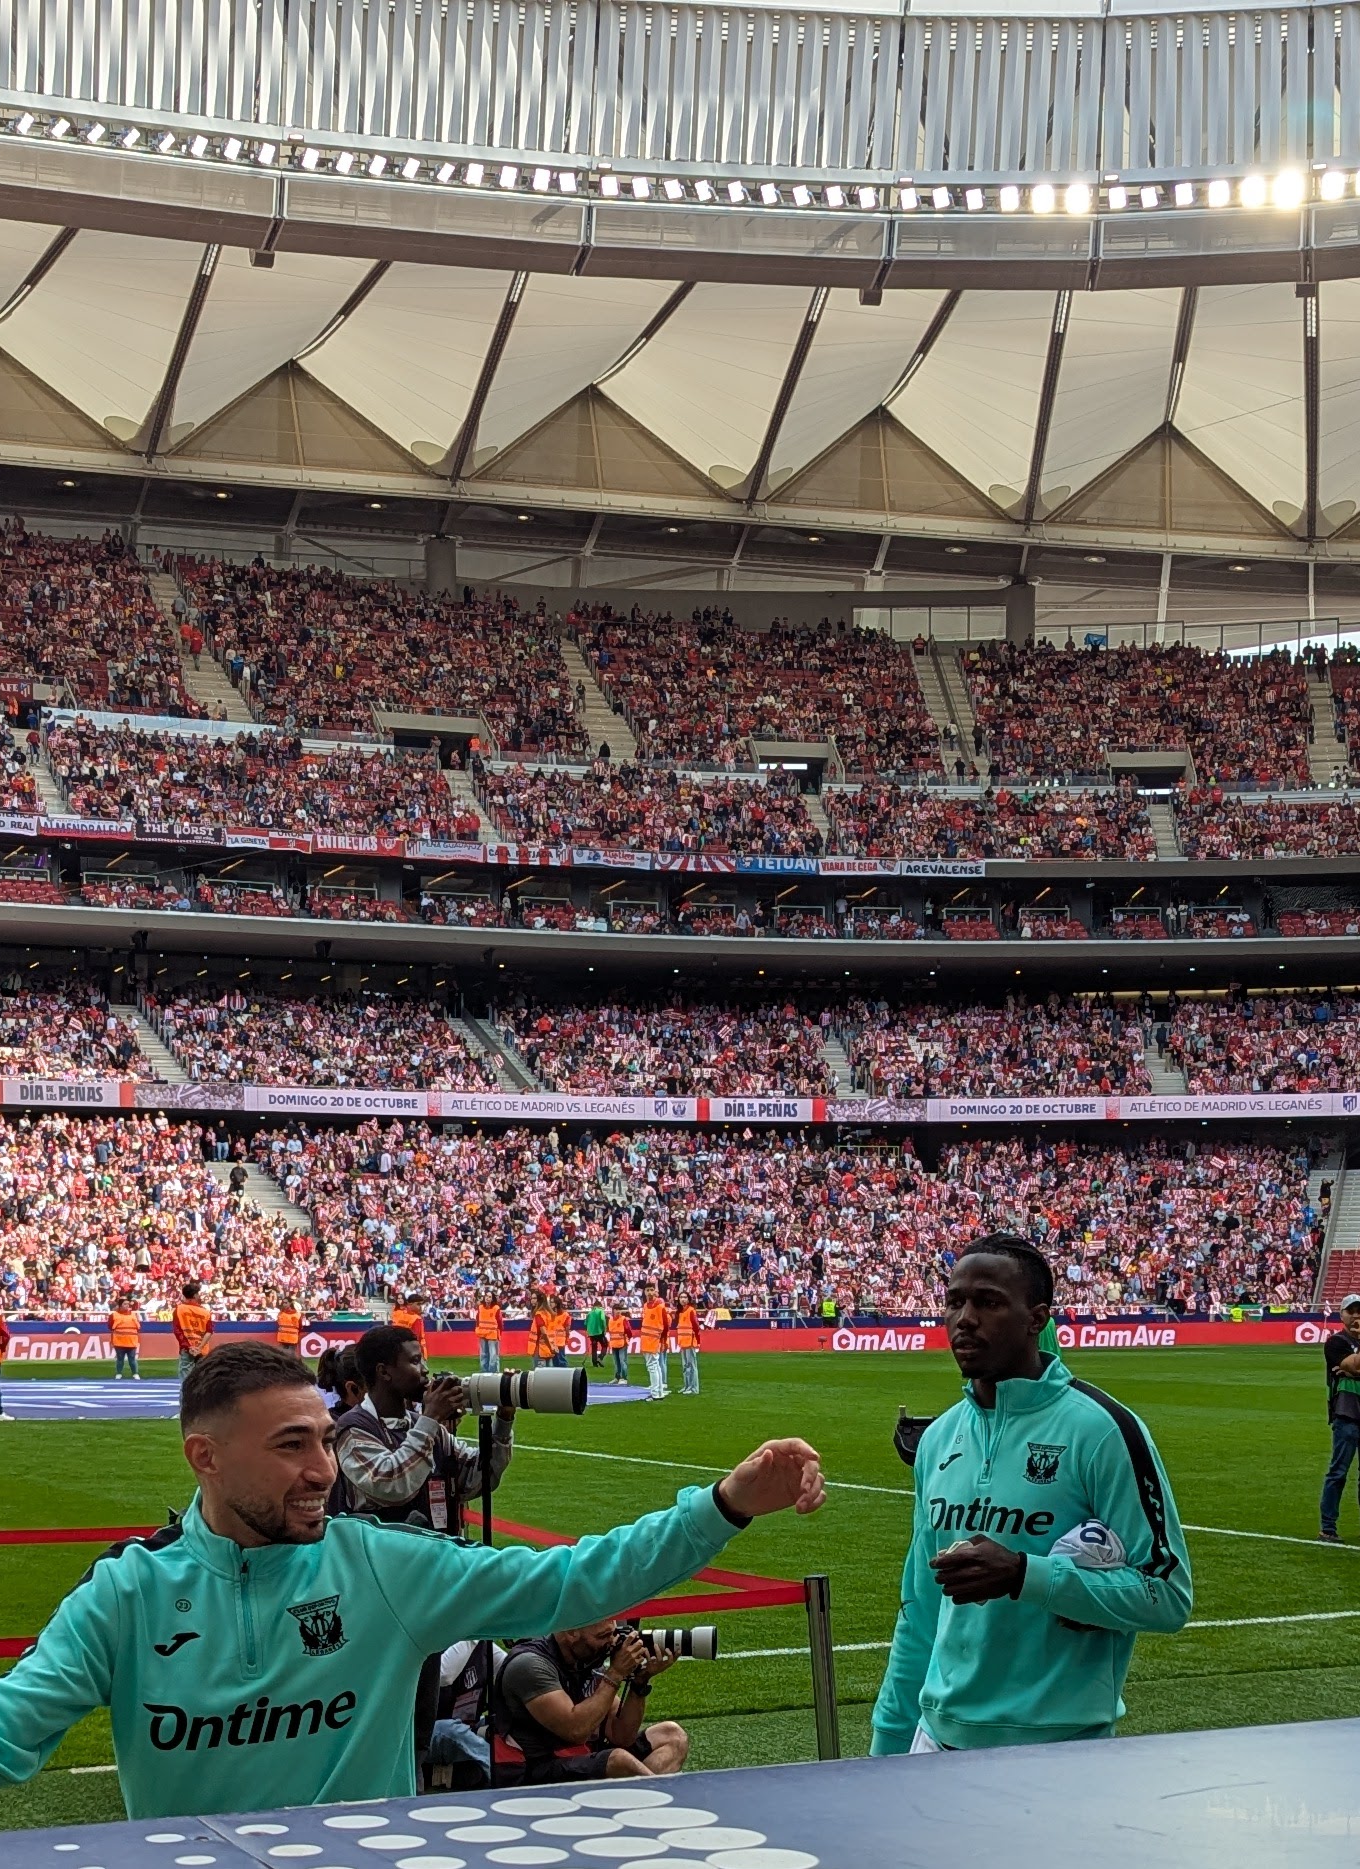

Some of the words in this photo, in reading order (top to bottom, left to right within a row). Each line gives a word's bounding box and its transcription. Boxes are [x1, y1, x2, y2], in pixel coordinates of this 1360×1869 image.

[10, 819, 34, 832] REAL
[143, 823, 168, 834] THE
[905, 862, 983, 875] AREVALENSE
[20, 1081, 44, 1101] DÍA
[59, 1082, 104, 1102] PEÑAS
[268, 1094, 327, 1106] DOMINGO
[330, 1096, 344, 1107] 20
[346, 1097, 362, 1108] DE
[364, 1098, 419, 1109] OCTUBRE
[451, 1098, 502, 1111] ATLÉTICO
[504, 1100, 518, 1112] DE
[521, 1101, 564, 1113] MADRID
[566, 1102, 582, 1113] VS.
[584, 1101, 635, 1114] LEGANÉS
[724, 1099, 745, 1117] DÍA
[758, 1099, 798, 1118] PEÑAS
[950, 1105, 1007, 1115] DOMINGO
[1009, 1104, 1023, 1115] 20
[1025, 1104, 1040, 1114] DE
[1042, 1103, 1096, 1114] OCTUBRE
[1130, 1100, 1182, 1112] ATLÉTICO
[1184, 1101, 1199, 1112] DE
[1201, 1101, 1247, 1112] MADRID
[1249, 1100, 1266, 1111] VS.
[1268, 1097, 1322, 1111] LEGANÉS
[1080, 1325, 1176, 1347] ComAve
[929, 1497, 1055, 1537] Ontime
[143, 1690, 357, 1751] Ontime
